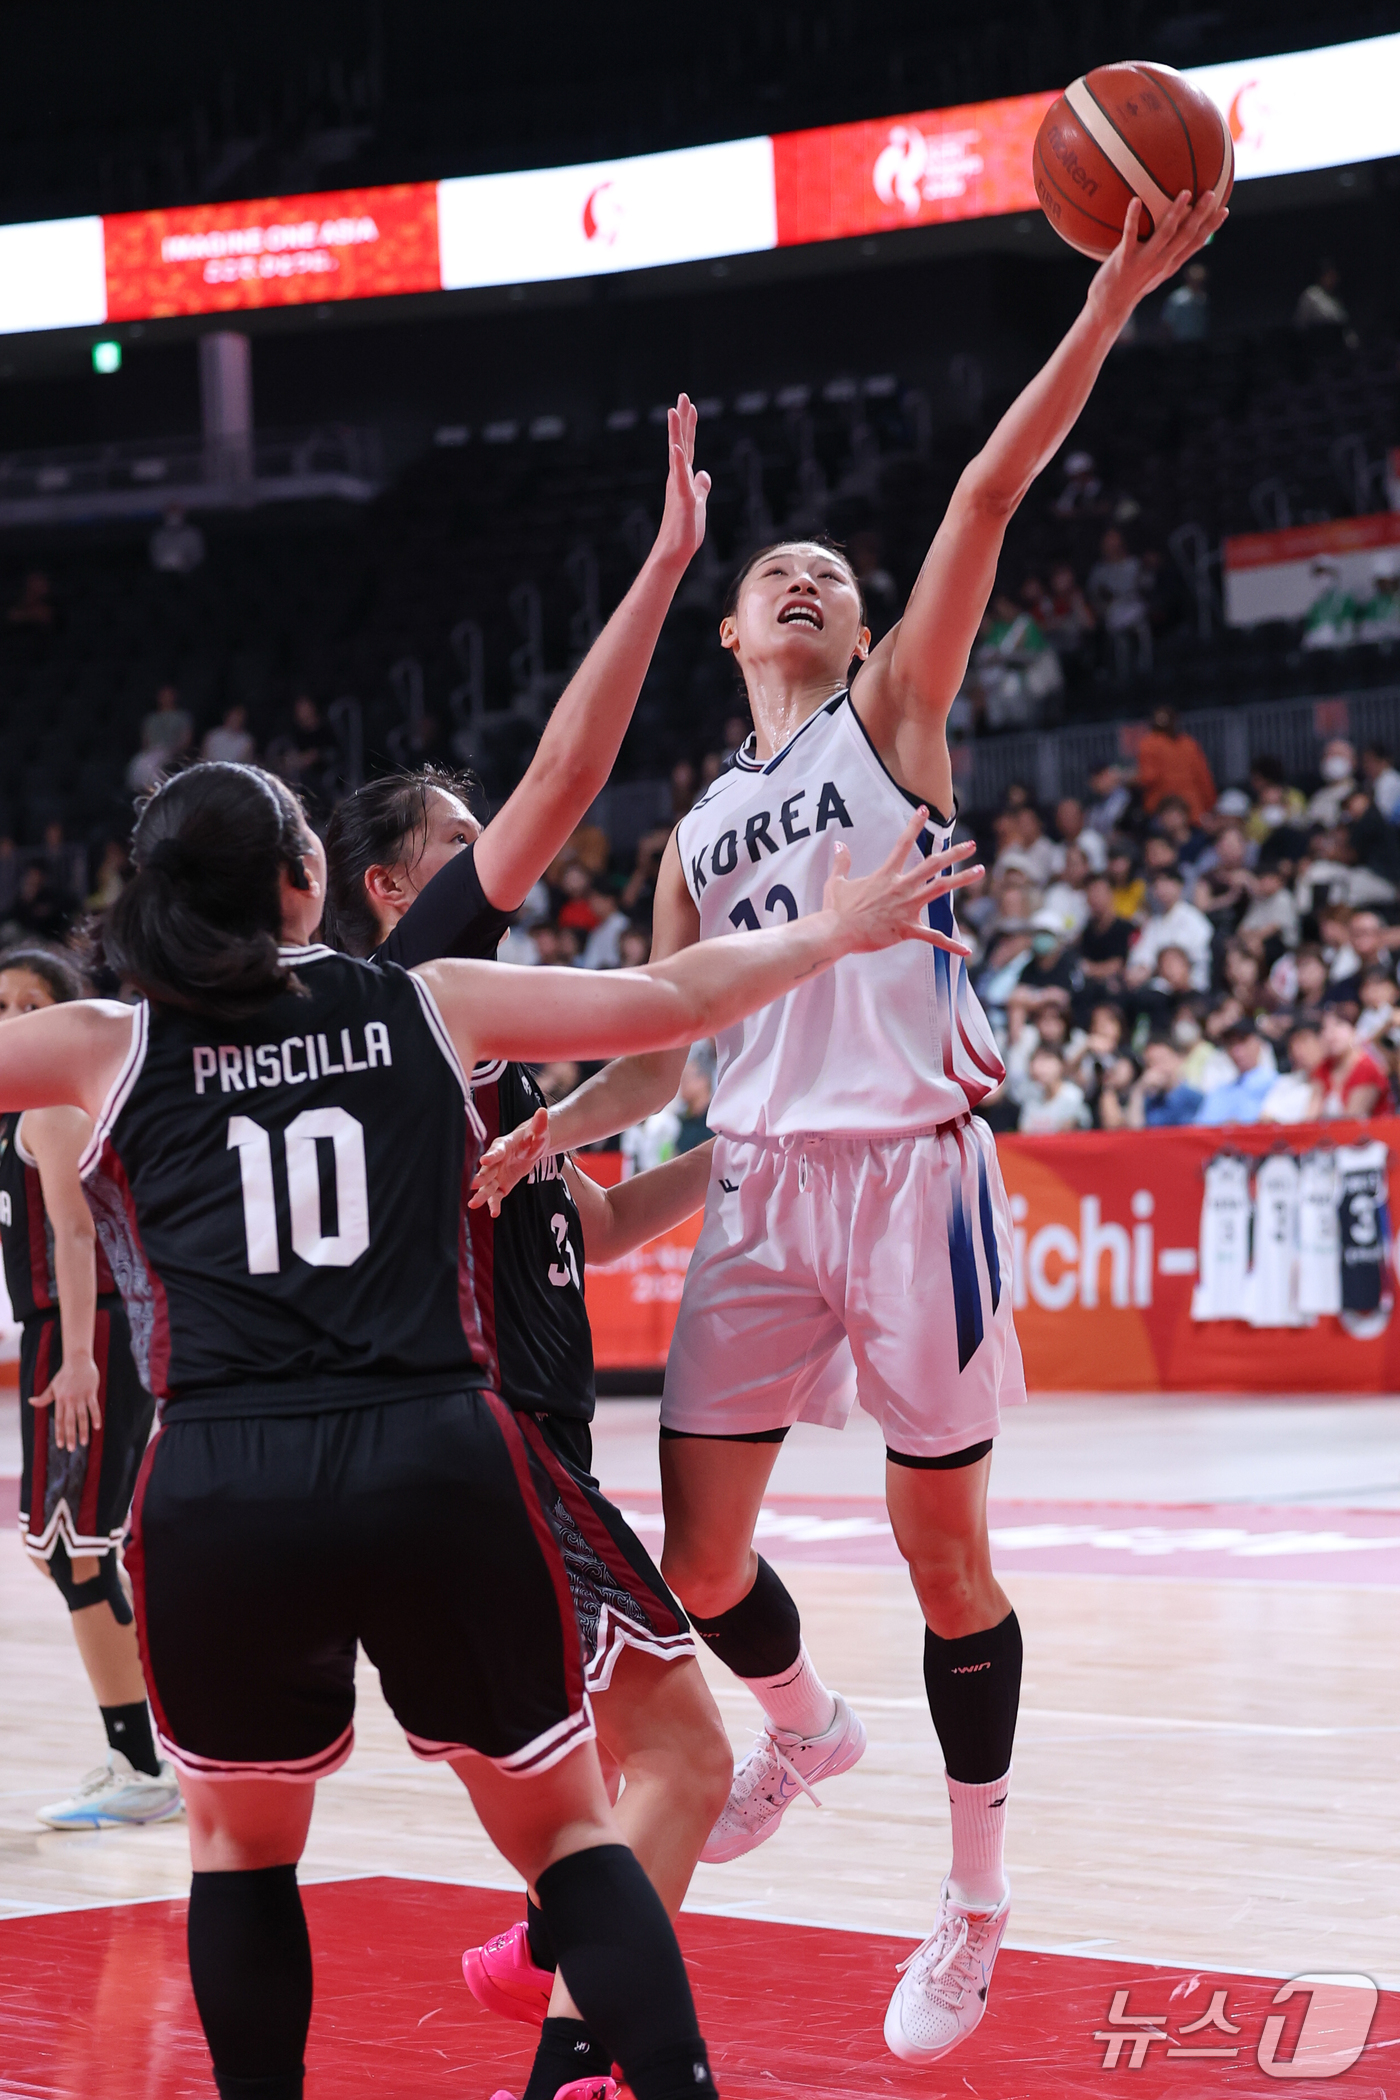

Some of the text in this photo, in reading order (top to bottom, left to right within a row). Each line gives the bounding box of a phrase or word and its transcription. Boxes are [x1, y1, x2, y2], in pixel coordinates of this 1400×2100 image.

[1047, 126, 1099, 198] molten
[1037, 178, 1063, 220] FIBA
[691, 781, 855, 900] KOREA
[193, 1021, 393, 1095] PRISCILLA
[226, 1106, 370, 1276] 10
[1349, 1194, 1378, 1247] 3
